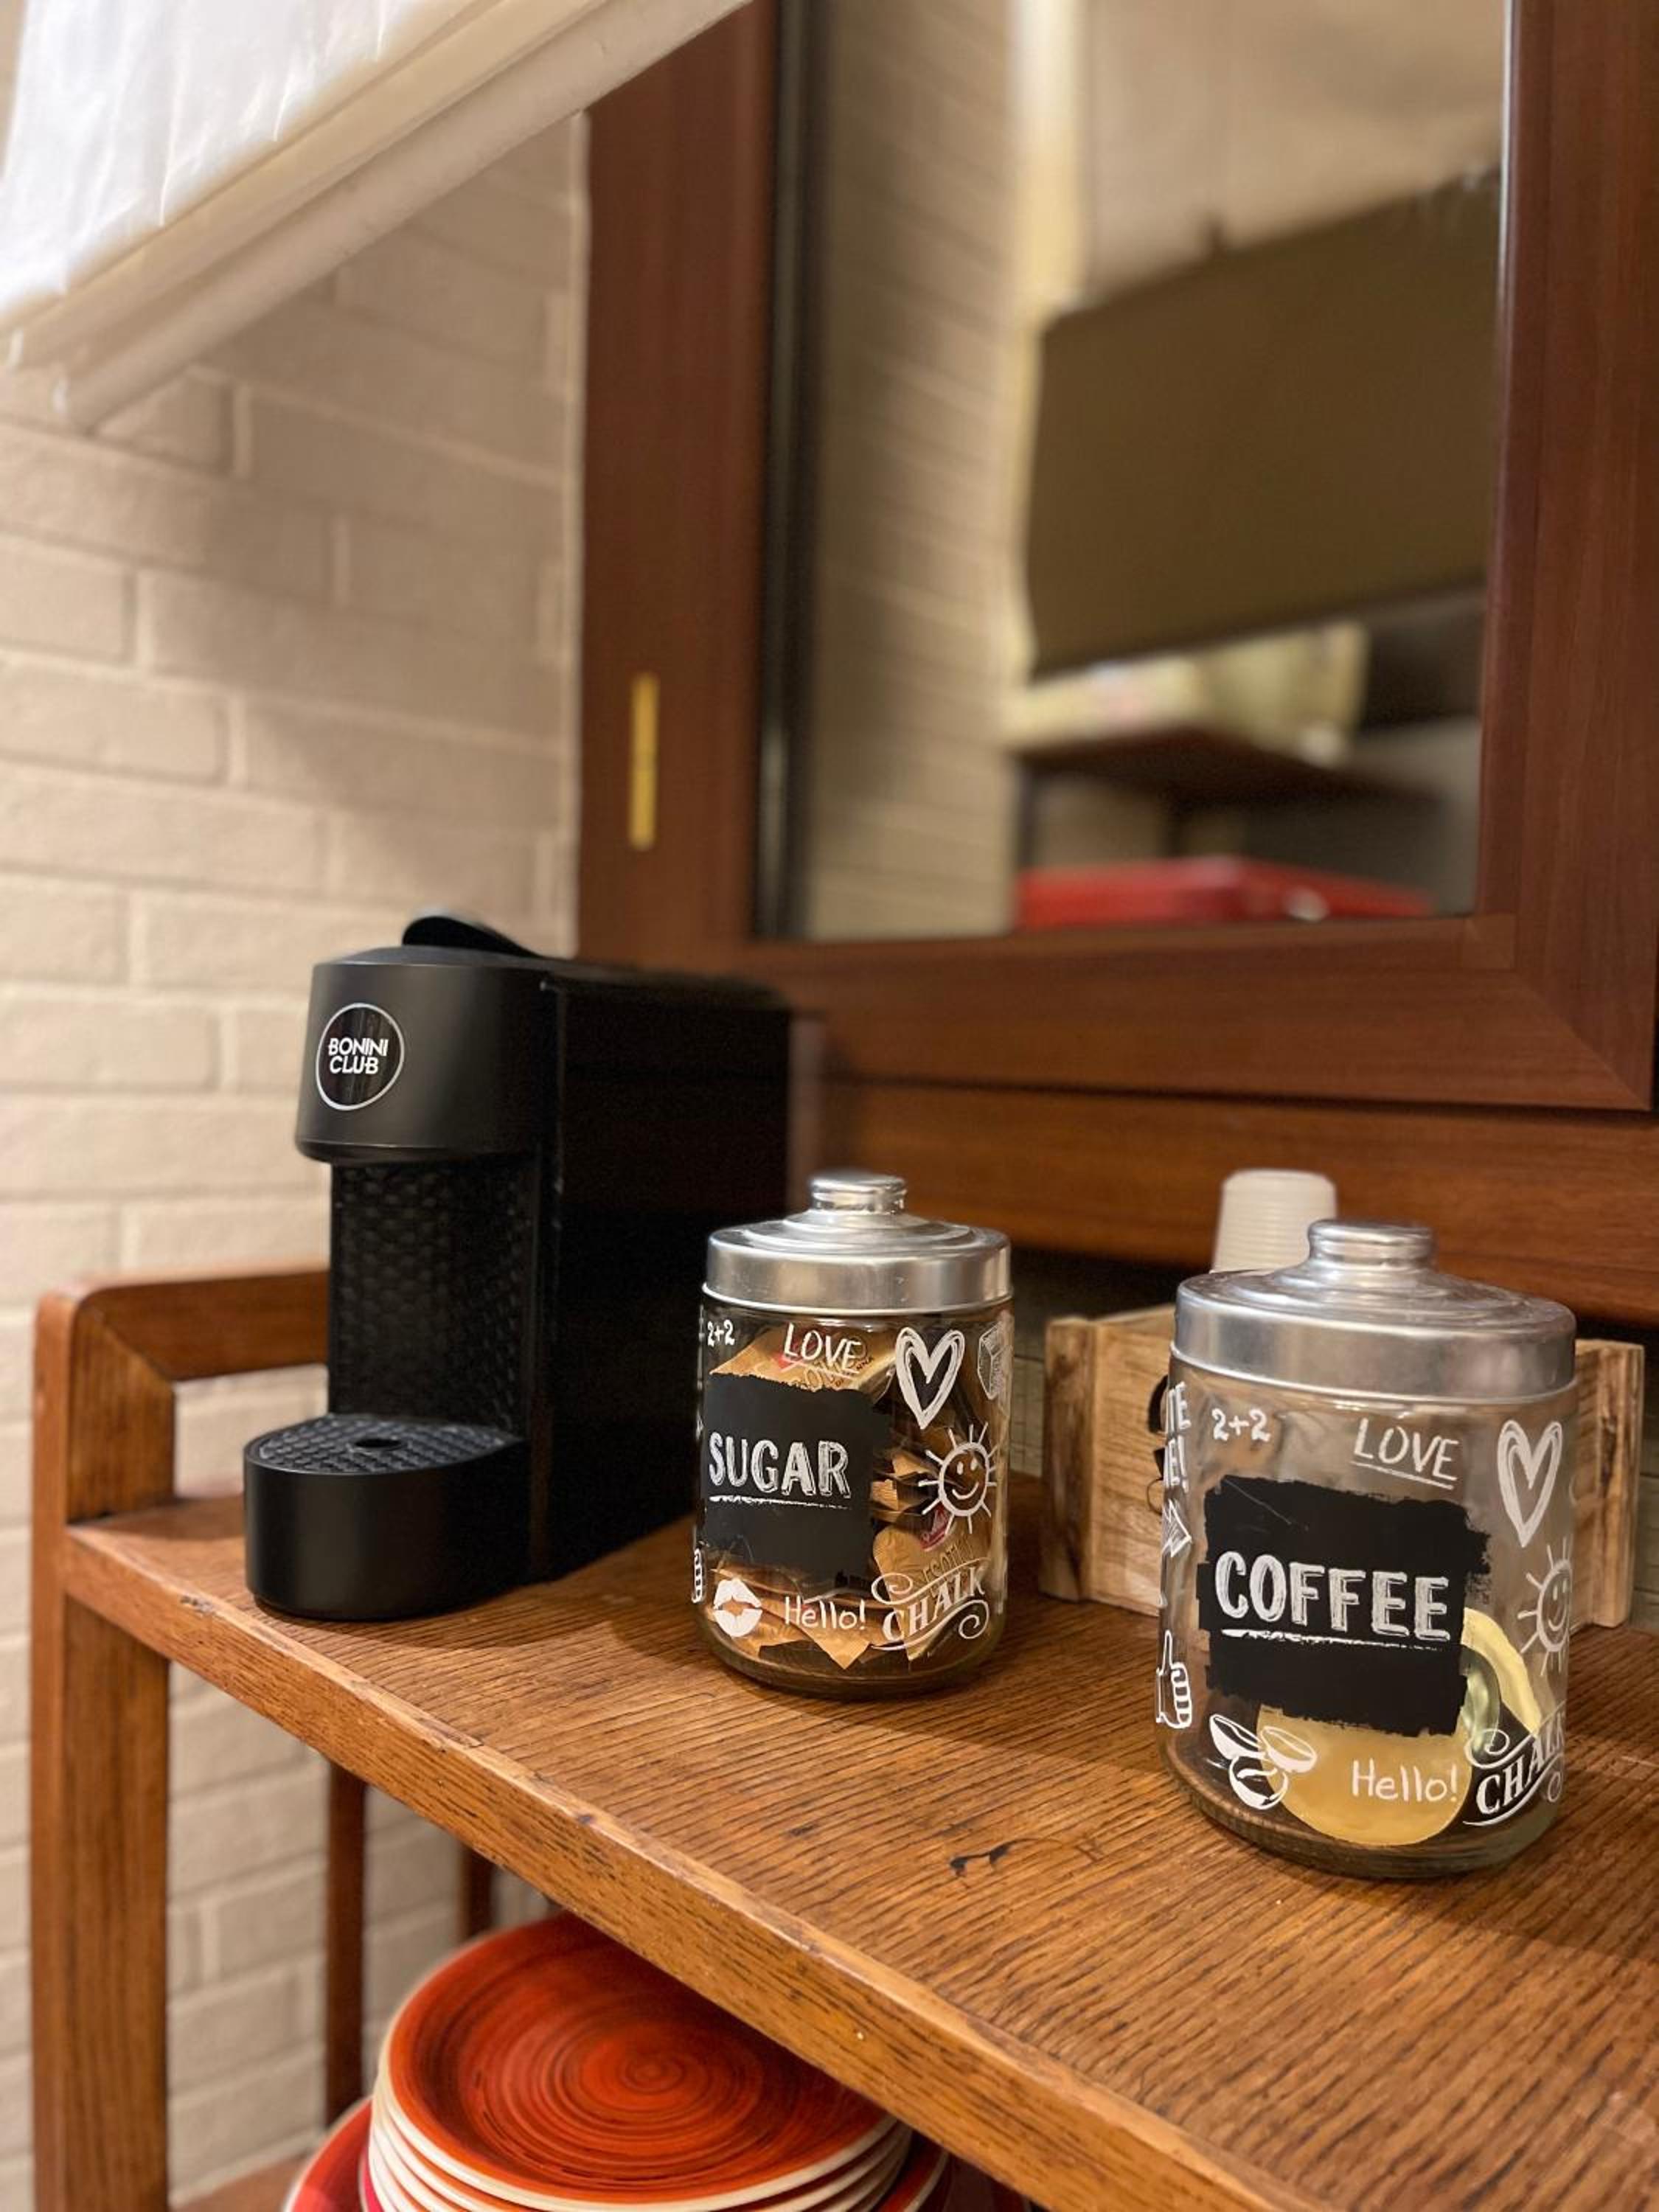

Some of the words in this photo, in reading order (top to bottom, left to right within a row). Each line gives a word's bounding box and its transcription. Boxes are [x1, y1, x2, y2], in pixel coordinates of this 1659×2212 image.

[328, 1037, 389, 1057] BONINI
[330, 1055, 379, 1074] CLUB
[707, 1319, 735, 1347] 2+2
[785, 1323, 861, 1373] LOVE
[1211, 1408, 1271, 1442] 2+2
[709, 1431, 852, 1499] SUGAR
[1354, 1417, 1459, 1481] LOVE
[785, 1595, 866, 1630] Hello!
[883, 1568, 985, 1641] CHALK
[1215, 1551, 1450, 1641] COFFEE
[1352, 1758, 1458, 1802] Hello!
